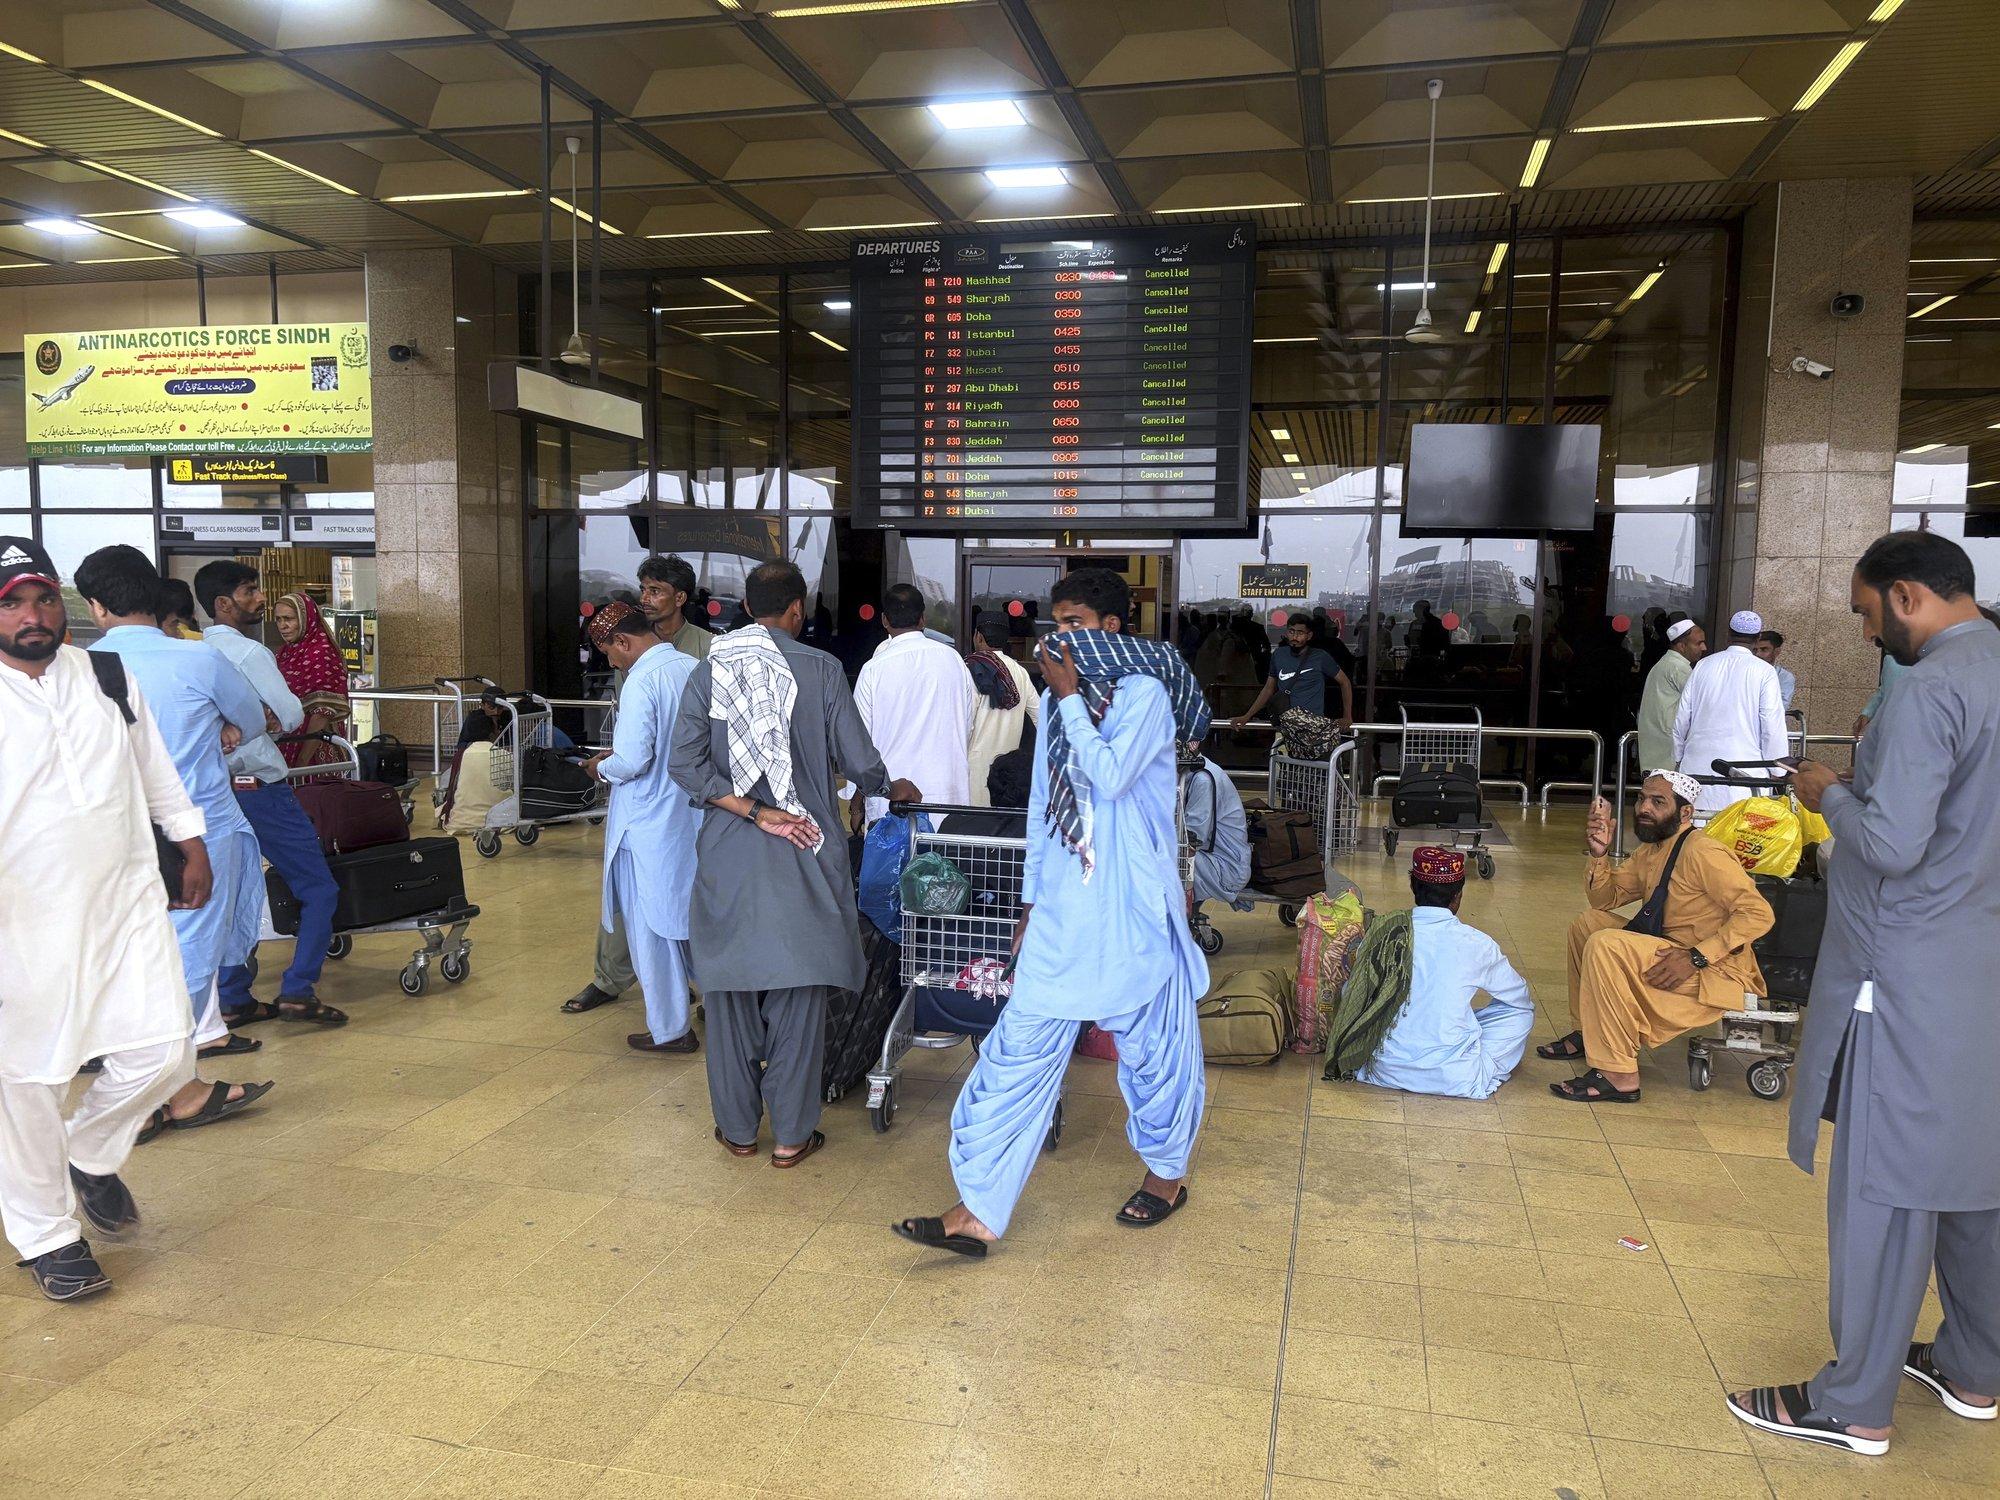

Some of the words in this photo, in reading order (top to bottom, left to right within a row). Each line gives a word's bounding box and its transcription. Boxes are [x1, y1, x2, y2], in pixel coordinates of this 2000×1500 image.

[857, 240, 940, 256] DEPARTURES
[925, 279, 936, 287] HH
[943, 277, 962, 286] 7210
[966, 275, 1011, 285] Mashhad
[1055, 272, 1082, 282] 0230
[1145, 269, 1189, 278] Cancelled
[925, 296, 936, 304] G9
[947, 295, 962, 304] 549
[966, 294, 1010, 305] Sharjah
[1055, 291, 1082, 300] 0300
[1145, 288, 1189, 297] Cancelled
[966, 312, 992, 321] Doha
[1055, 309, 1081, 318] 0350
[1144, 306, 1188, 315] Cancelled
[77, 331, 210, 351] ANTINARCOTICS
[215, 328, 271, 346] FORCE
[277, 327, 330, 344] SINDH
[925, 331, 936, 340] PC
[948, 331, 960, 339] 131
[967, 330, 1015, 339] Istanbul
[1054, 327, 1081, 336] 0425
[1144, 325, 1188, 333] Cancelled
[966, 348, 996, 357] Dubai
[1054, 345, 1080, 354] 0455
[1143, 343, 1187, 351] Cancelled
[947, 367, 961, 375] 512
[966, 366, 1003, 374] Muscat
[1053, 364, 1080, 373] 0510
[1143, 361, 1187, 370] Cancelled
[924, 384, 935, 393] EY
[947, 384, 961, 393] 297
[965, 383, 984, 392] Abu
[988, 383, 1019, 392] Dhabi
[1053, 382, 1080, 390] 0515
[1142, 379, 1186, 388] Cancelled
[924, 402, 935, 411] XY
[947, 402, 960, 411] 314
[965, 402, 1002, 412] Riyadh
[1053, 400, 1079, 408] 0600
[1142, 398, 1186, 406] Cancelled
[947, 420, 960, 428] 751
[965, 419, 1009, 428] Bahrain
[1053, 417, 1079, 426] 0650
[1142, 416, 1185, 425] Cancelled
[924, 437, 935, 446] F3
[965, 437, 1002, 445] Jeddah
[1052, 435, 1079, 444] 0800
[1141, 434, 1184, 443] Cancelled
[81, 444, 93, 453] For
[94, 446, 106, 454] any
[107, 443, 144, 453] Information
[144, 442, 167, 452] Please
[168, 442, 195, 451] Contact
[207, 441, 219, 450] toll
[220, 441, 236, 450] Free
[924, 455, 935, 463] SV
[965, 454, 1002, 463] Jeddah
[1052, 453, 1078, 462] 0905
[1141, 452, 1184, 461] Cancelled
[194, 472, 210, 481] Fast
[210, 472, 231, 481] Track
[946, 472, 960, 481] 611
[965, 472, 990, 481] Doha
[1053, 471, 1078, 480] 1015
[1140, 470, 1183, 479] Cancelled
[924, 490, 935, 498] G9
[964, 489, 1008, 499] Sharjah
[1053, 488, 1078, 497] 1035
[964, 506, 995, 515] Dubai
[1052, 506, 1078, 515] 1130
[1063, 530, 1070, 546] 1
[1242, 588, 1263, 596] STAFF
[1264, 588, 1286, 596] ENTRY
[1287, 588, 1304, 596] GATE
